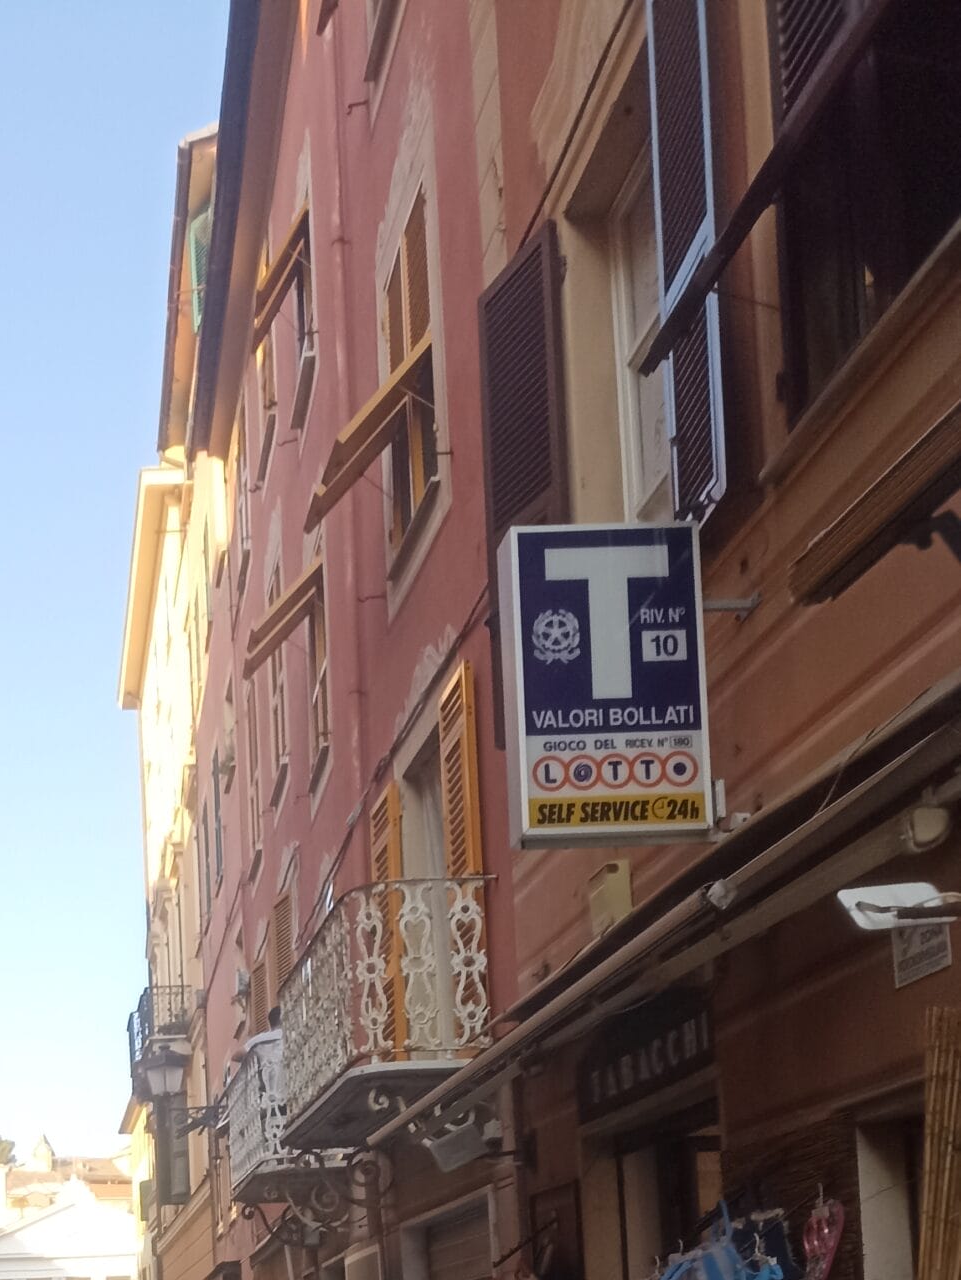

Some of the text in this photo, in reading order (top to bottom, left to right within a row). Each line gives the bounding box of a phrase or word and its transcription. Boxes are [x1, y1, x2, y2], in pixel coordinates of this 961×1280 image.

[544, 544, 669, 700] T
[640, 609, 665, 624] RIV.
[651, 634, 679, 656] 10
[532, 704, 694, 729] VALORI BOLLATI
[543, 739, 617, 752] GIOCO DEL
[537, 797, 699, 825] SELF SERVICE 24h
[591, 1011, 709, 1103] TABACCHI
